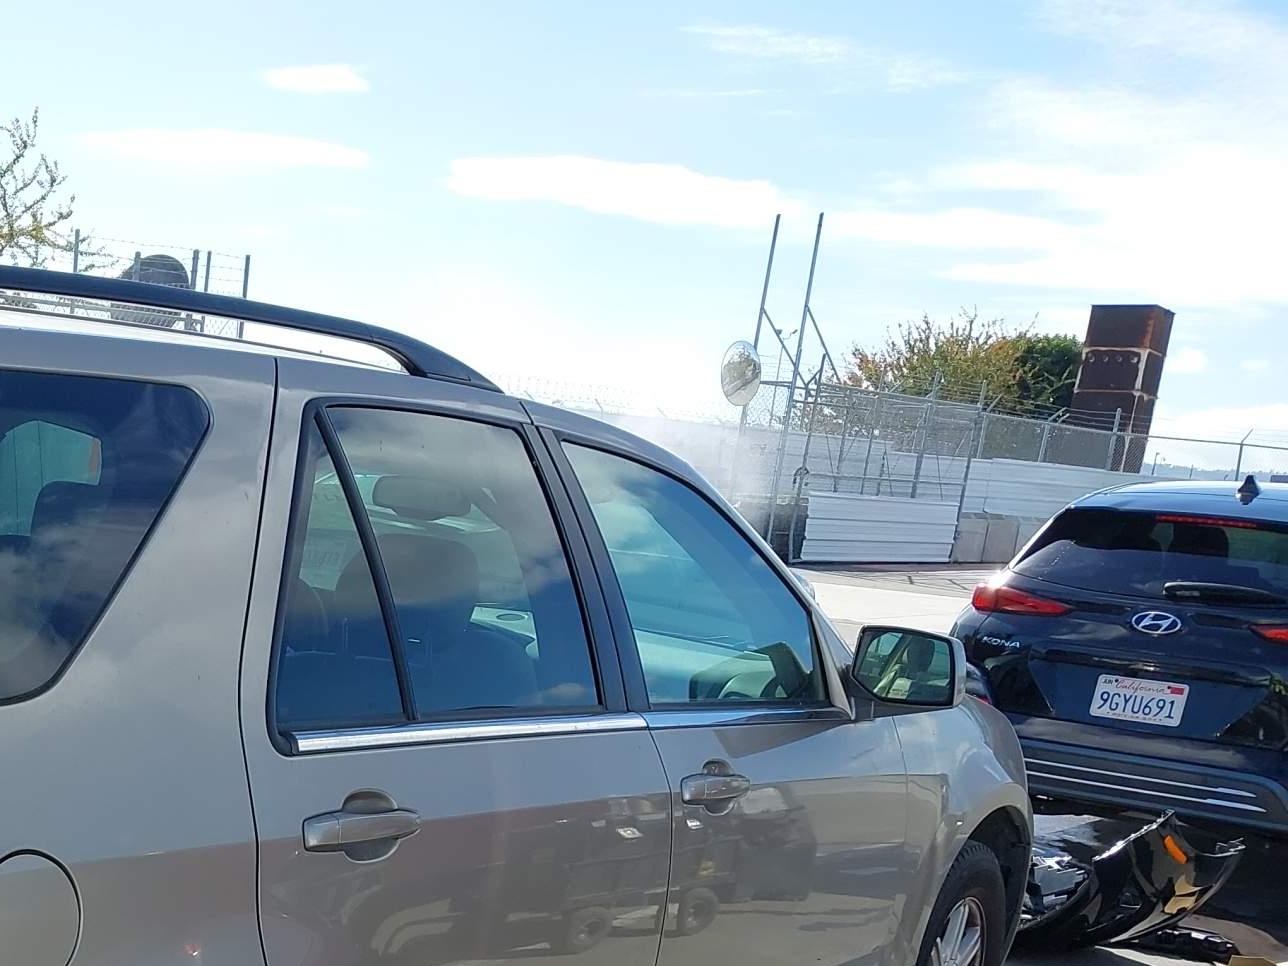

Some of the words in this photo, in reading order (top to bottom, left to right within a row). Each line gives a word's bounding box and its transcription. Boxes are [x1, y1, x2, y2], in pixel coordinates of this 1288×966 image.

[983, 636, 1020, 648] KONA
[1115, 680, 1167, 695] California
[1097, 691, 1176, 720] 9GYU691
